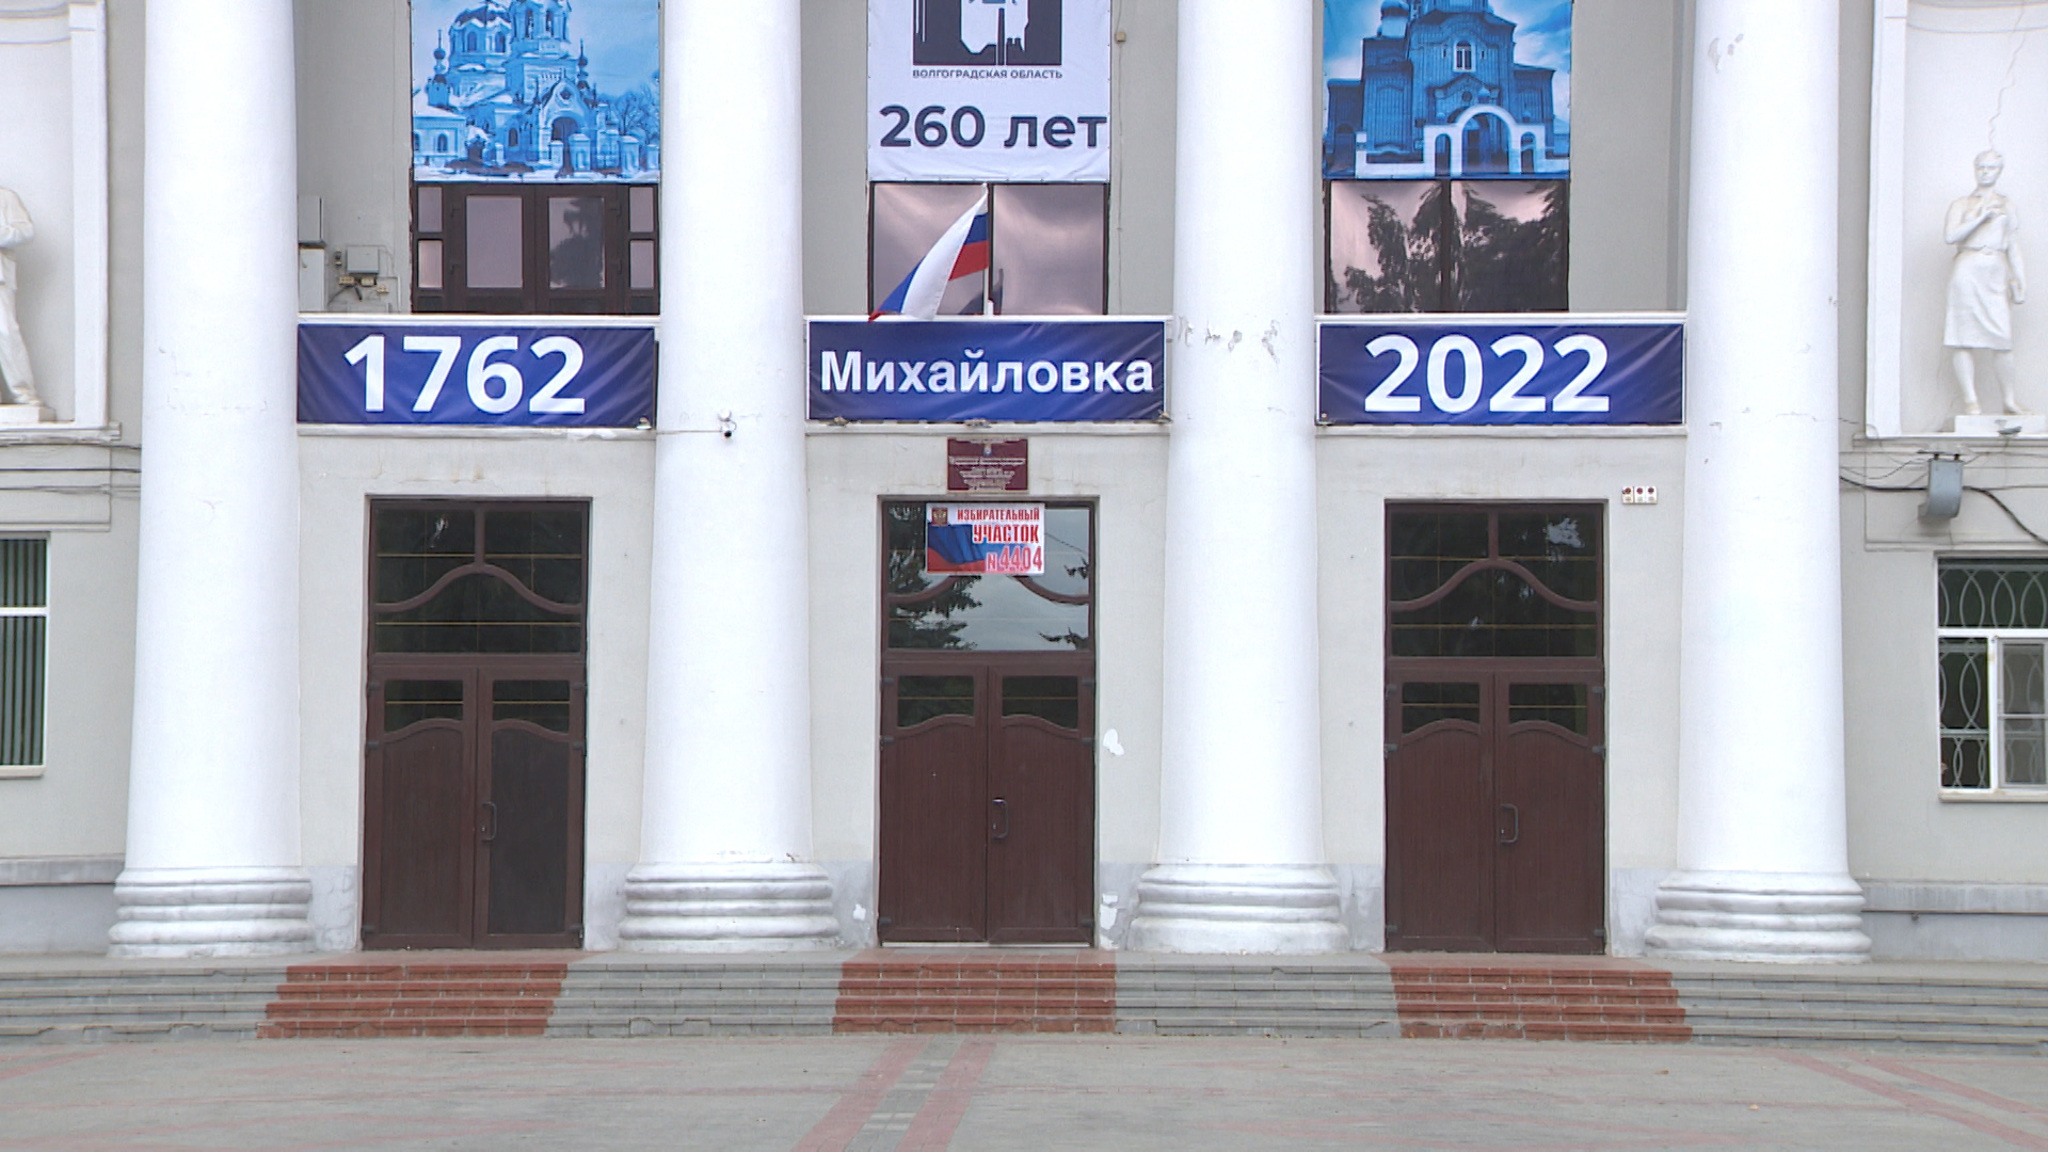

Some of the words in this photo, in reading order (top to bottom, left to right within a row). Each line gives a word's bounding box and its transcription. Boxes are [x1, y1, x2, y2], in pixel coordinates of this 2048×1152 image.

[912, 69, 1007, 80] ВОЛГОГРАДСКАЯ
[1010, 69, 1063, 79] ОБЛАСТЬ
[879, 104, 986, 148] 260
[1003, 115, 1108, 148] лет
[343, 333, 586, 415] 1762
[820, 348, 1154, 394] Михайловка
[1364, 333, 1610, 414] 2022
[957, 507, 1040, 521] ИЗБИРАТЕЛЬНЫЙ
[973, 525, 1039, 543] УЧАСТОК
